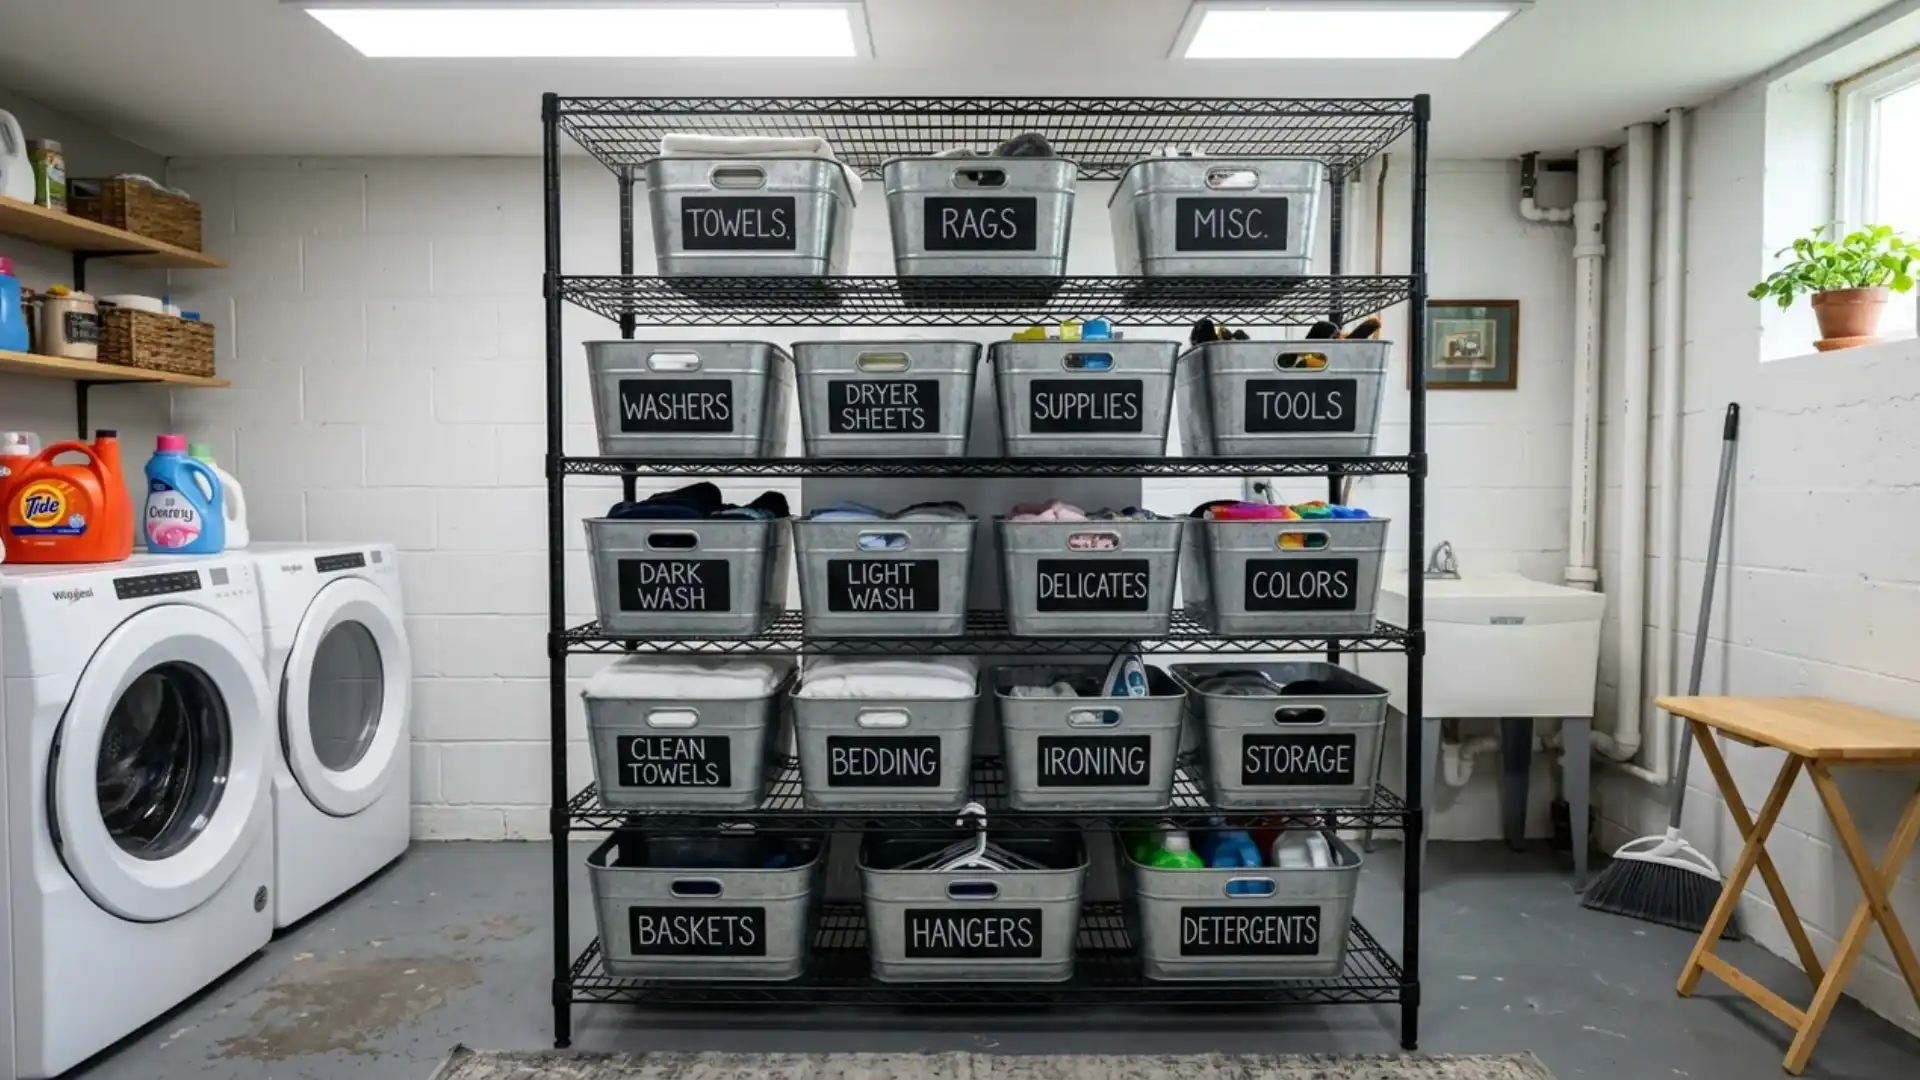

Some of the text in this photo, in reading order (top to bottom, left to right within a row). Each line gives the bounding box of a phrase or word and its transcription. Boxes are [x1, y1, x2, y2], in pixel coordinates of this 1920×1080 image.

[942, 207, 1017, 239] RAGS
[1194, 208, 1268, 239] MISC.
[622, 392, 729, 420] WASHERS
[846, 383, 918, 405] DRYER
[1034, 392, 1138, 420] SUPPLIES
[1256, 391, 1343, 420] TOOLS
[841, 407, 925, 430] SHEETS
[25, 495, 60, 519] Tide
[640, 562, 702, 585] DARK
[848, 563, 915, 585] LIGHT
[1039, 572, 1147, 599] DELICATES
[1252, 570, 1348, 599] COLORS
[637, 586, 705, 609] WASH
[847, 587, 914, 610] WASH
[631, 737, 705, 760] CLEAN
[832, 747, 936, 775] BEDDING
[1044, 746, 1145, 775] IRONING
[1246, 745, 1350, 774] STORAGE
[627, 762, 719, 785] TOWELS
[639, 915, 755, 946] BASKETS
[913, 917, 1033, 948] HANGERS
[1184, 915, 1317, 945] DETERGENTS
